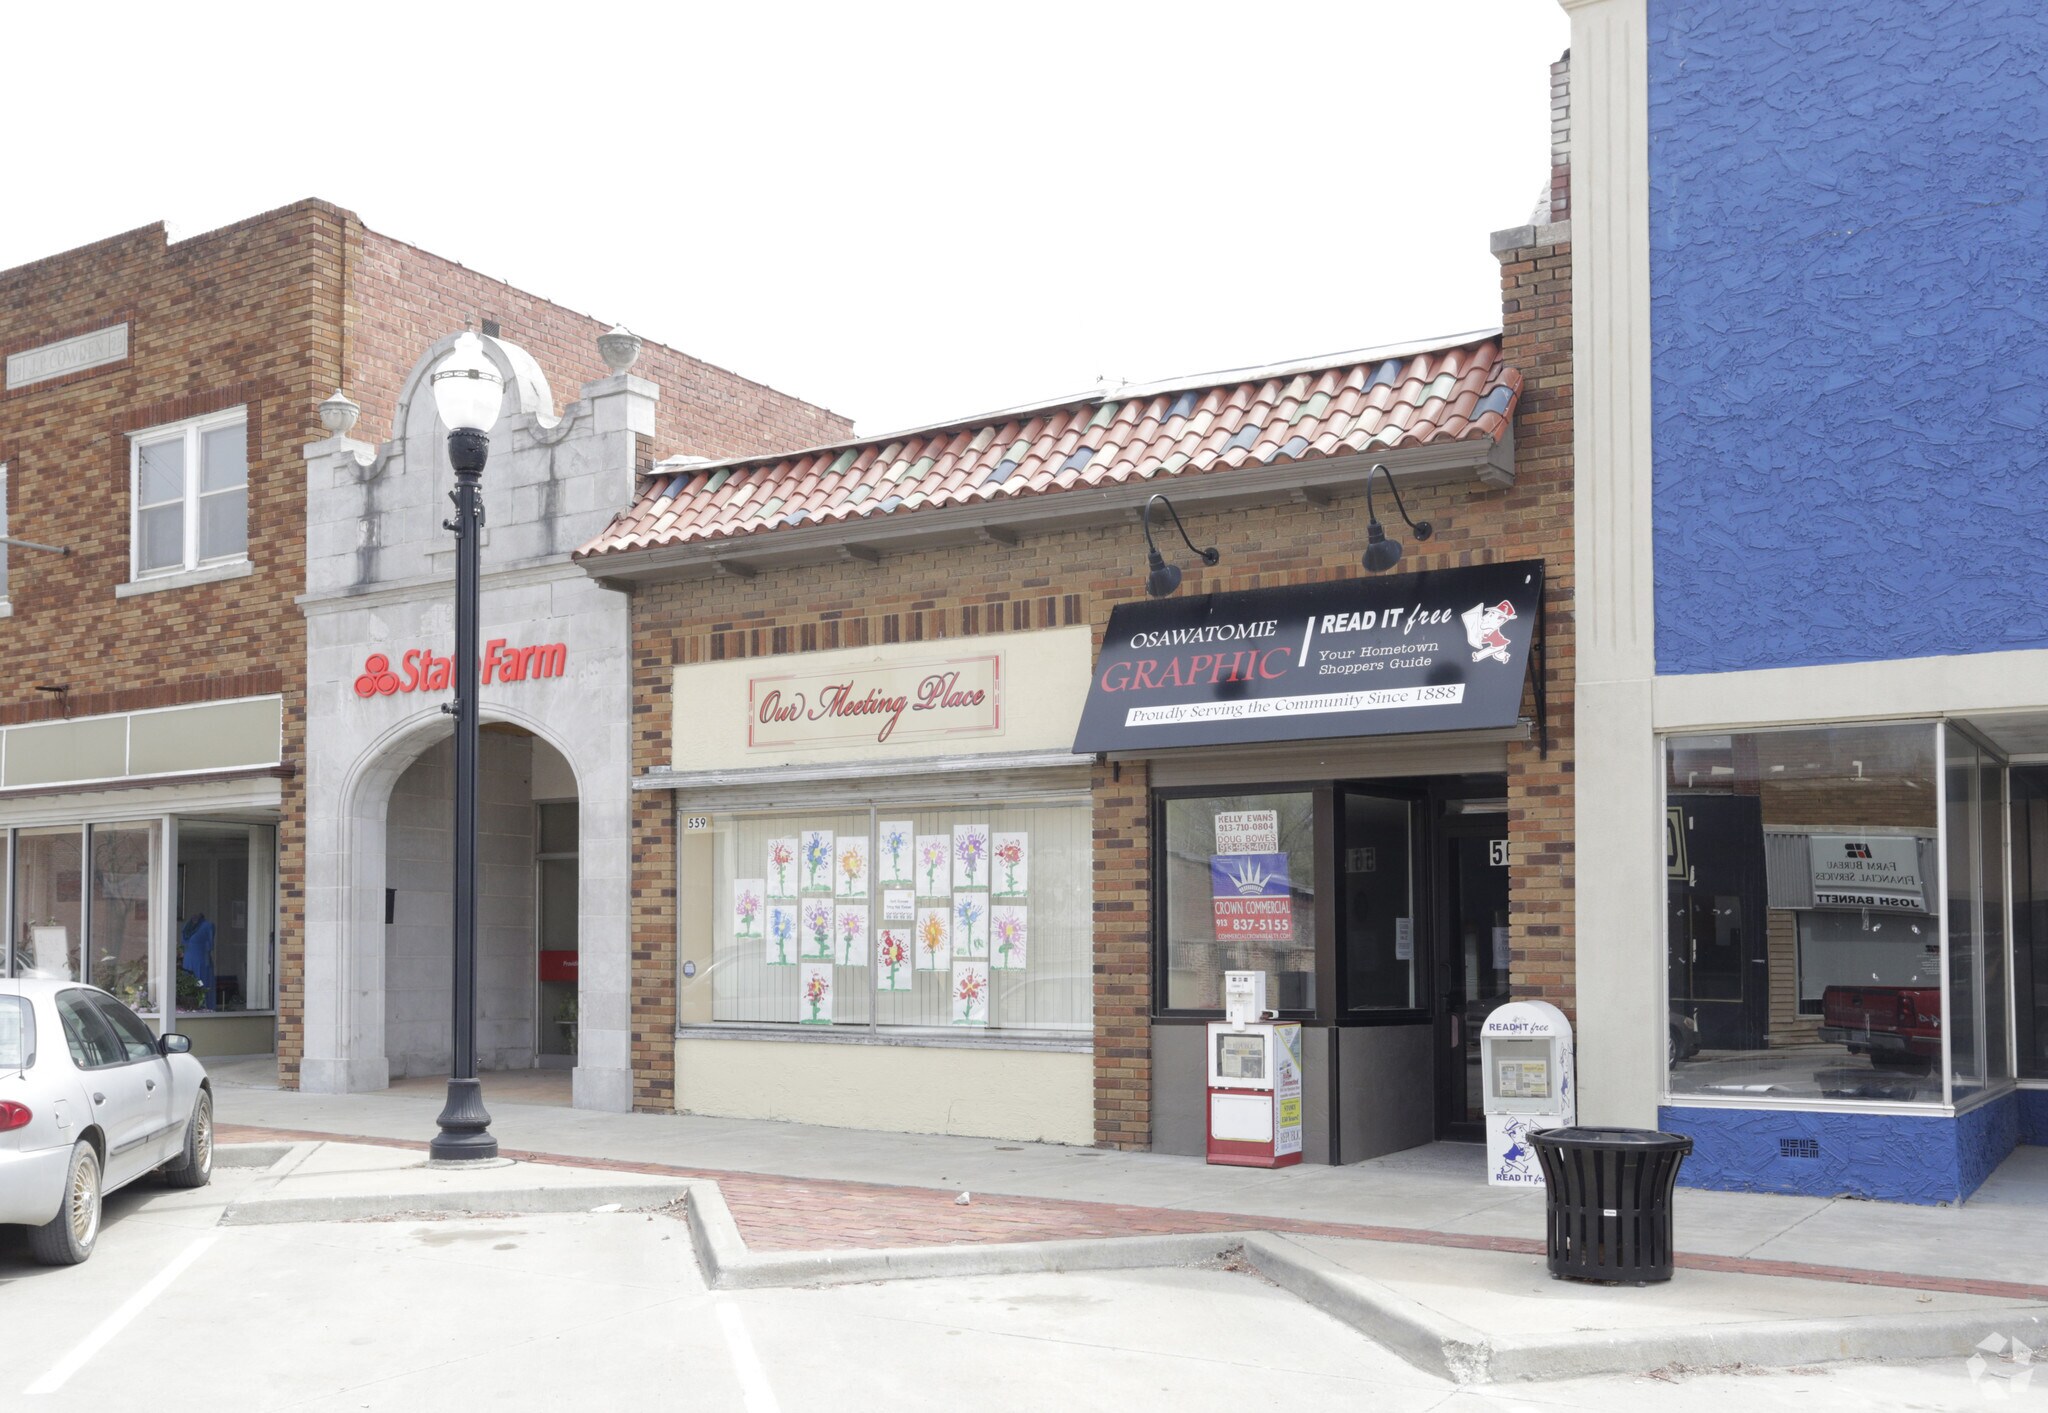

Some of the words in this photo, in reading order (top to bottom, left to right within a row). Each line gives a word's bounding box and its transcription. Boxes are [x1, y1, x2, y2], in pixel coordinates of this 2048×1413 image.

[1320, 610, 1377, 634] READ
[1381, 608, 1404, 628] IT
[1404, 603, 1452, 635] free
[1130, 620, 1278, 649] OSAWATOMIE
[1319, 648, 1355, 661] Your
[1360, 642, 1439, 657] Hometown
[400, 648, 481, 693] Sta
[481, 638, 567, 685] Farm
[1101, 647, 1291, 692] GRAPHIC
[1319, 661, 1384, 675] Shoppers
[1390, 656, 1432, 669] Guide
[760, 689, 806, 724] Our
[807, 680, 908, 743] Meeting
[912, 671, 986, 711] Place
[1132, 706, 1187, 722] Proudly
[1190, 703, 1243, 718] Serving
[1248, 701, 1271, 714] the
[1275, 694, 1362, 712] Community
[1367, 690, 1409, 703] Since
[1415, 686, 1456, 700] 1888
[688, 817, 706, 829] 559
[1218, 815, 1242, 823] KELLY
[1247, 814, 1274, 822] EVANS
[1218, 823, 1274, 831] 913-710-0804
[1218, 835, 1241, 843] DOUG
[1245, 834, 1277, 842] BOWES
[1492, 841, 1508, 865] 5
[1215, 901, 1243, 914] CROWN
[1245, 900, 1290, 914] COMMERCIAL
[1233, 919, 1289, 930] 837-5155
[1489, 1023, 1517, 1031] READ
[1518, 1023, 1529, 1031] IT
[1530, 1022, 1549, 1034] free
[1496, 1173, 1521, 1182] READ
[1524, 1174, 1533, 1182] IT
